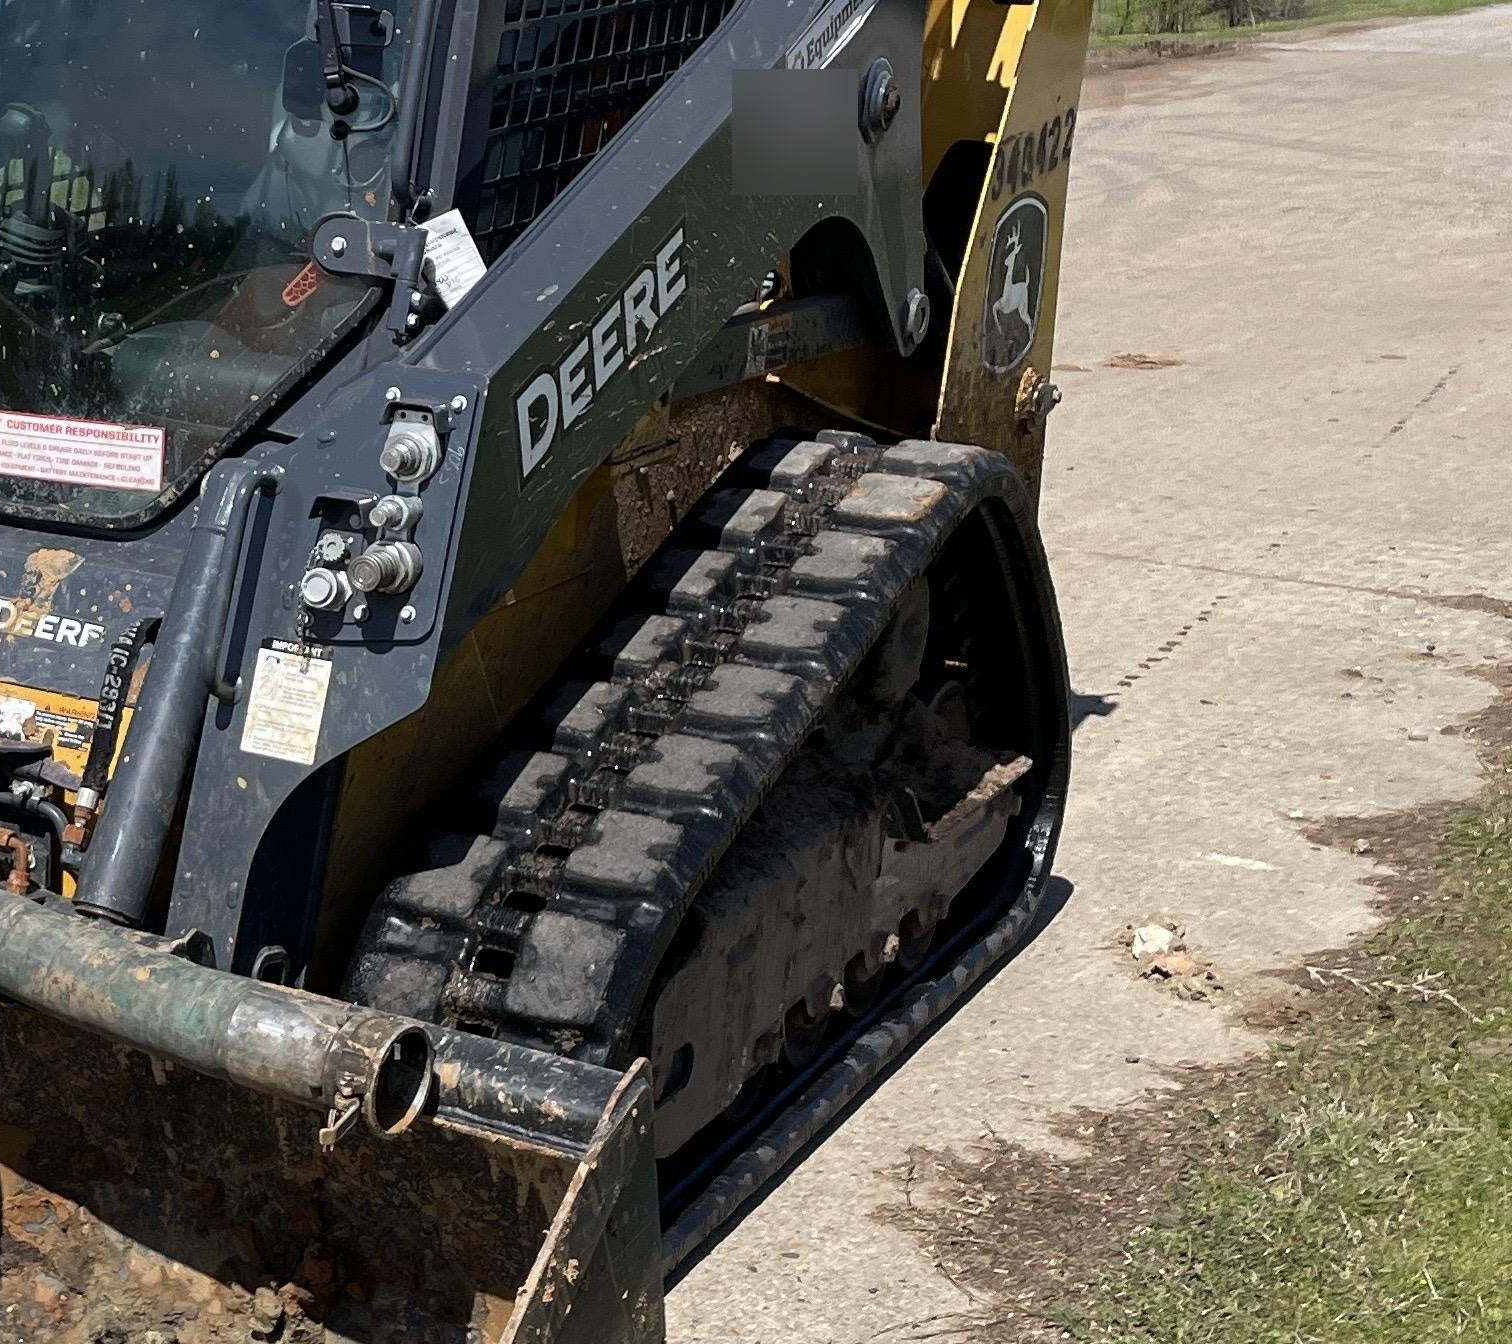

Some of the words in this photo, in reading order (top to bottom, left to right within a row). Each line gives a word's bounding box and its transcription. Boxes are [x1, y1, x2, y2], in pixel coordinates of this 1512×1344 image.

[516, 227, 687, 479] DEERE
[6, 419, 63, 434] CUSTOMER
[65, 425, 159, 445] RESPONSIBILITY
